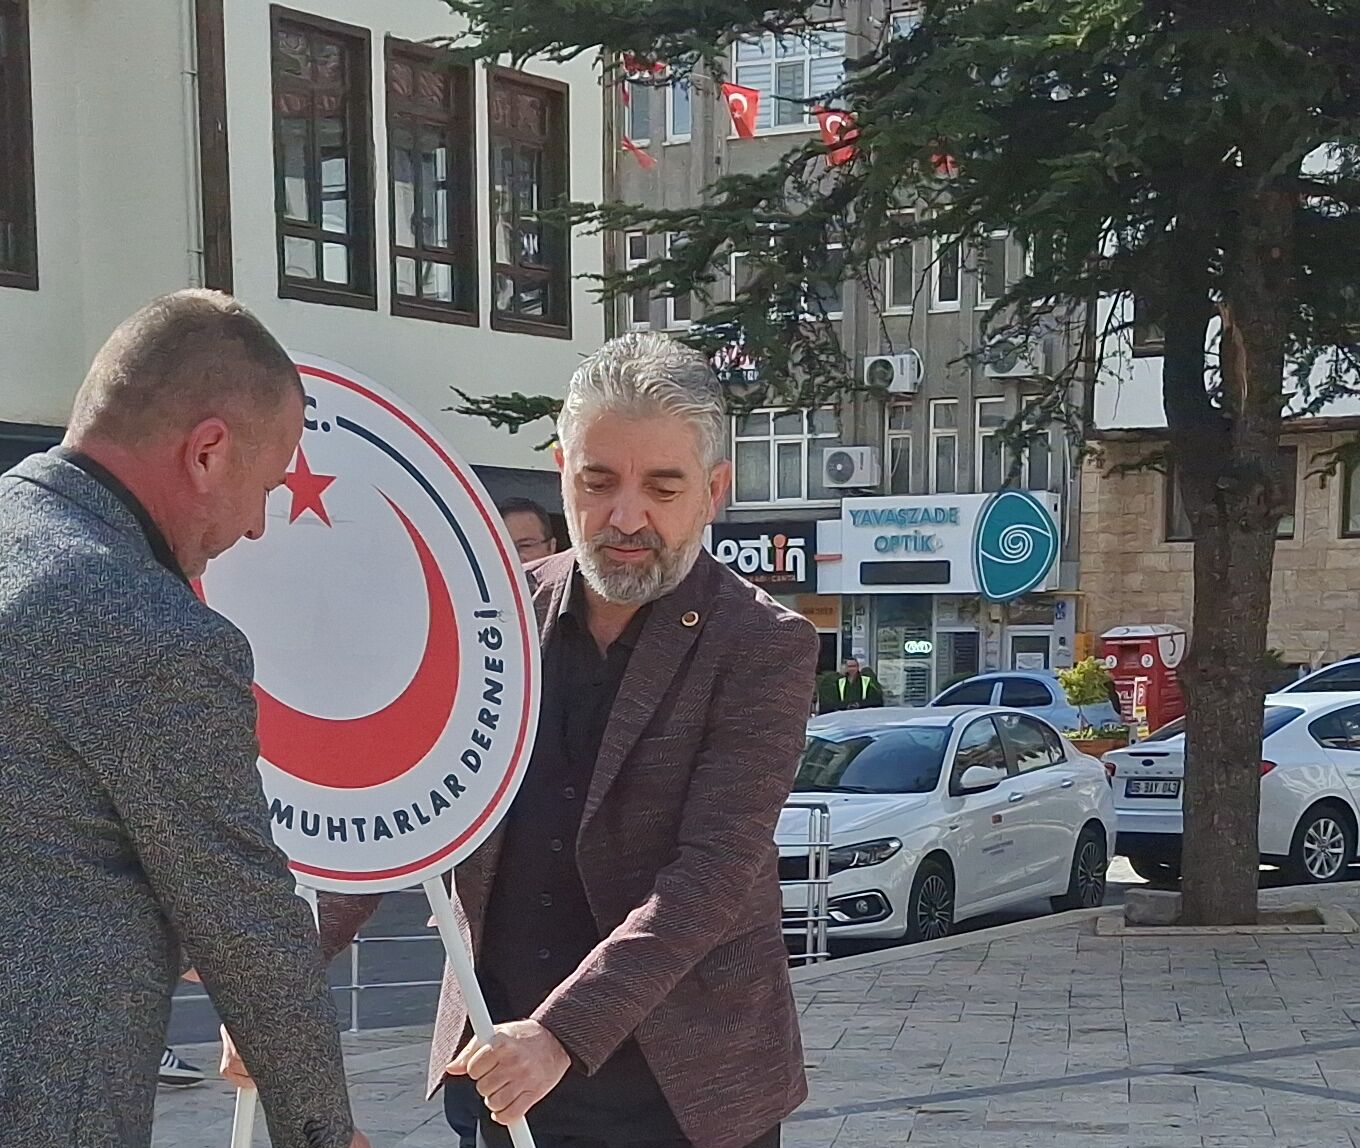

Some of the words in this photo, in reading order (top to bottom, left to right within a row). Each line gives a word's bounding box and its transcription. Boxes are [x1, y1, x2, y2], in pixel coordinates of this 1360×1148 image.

[848, 506, 960, 528] YAVAŞZADE
[874, 529, 935, 553] OPTİK
[269, 773, 467, 843] MUHTARLAR
[460, 609, 505, 774] DERNEĞİ
